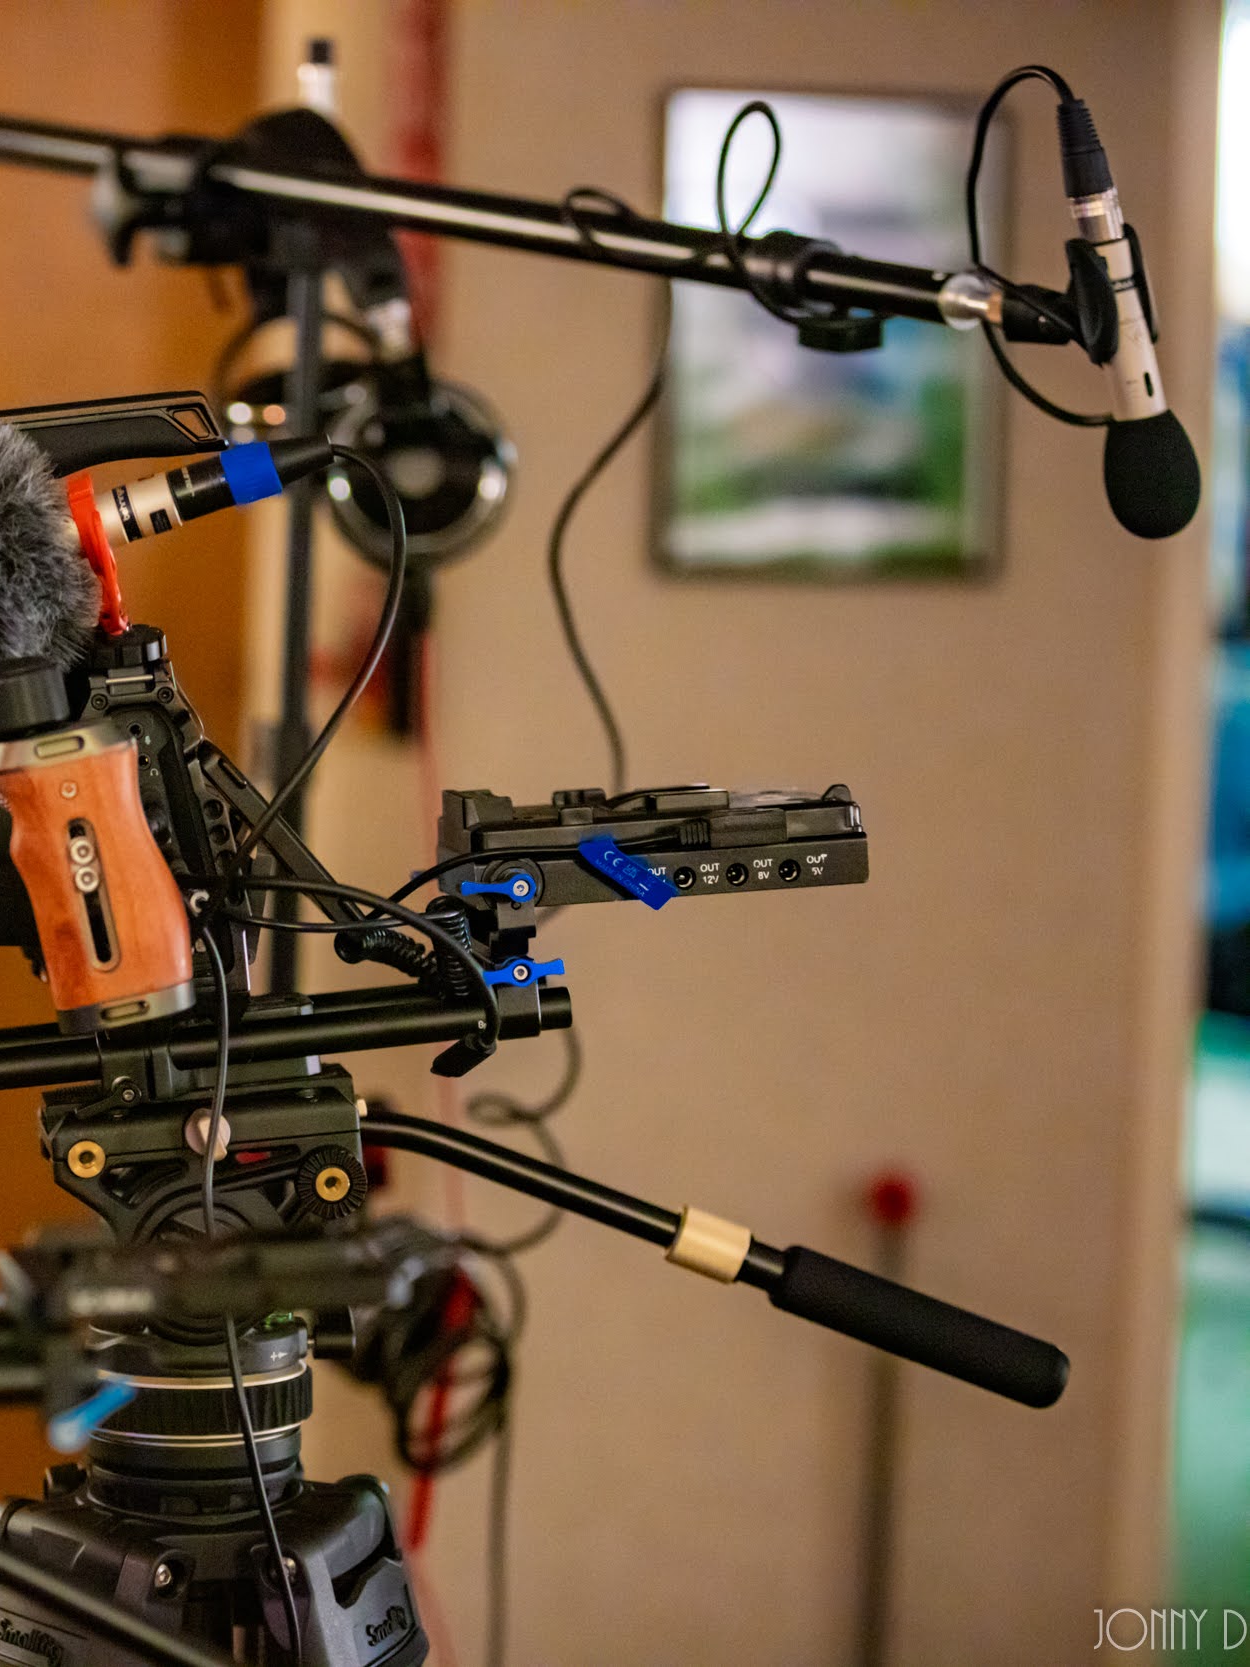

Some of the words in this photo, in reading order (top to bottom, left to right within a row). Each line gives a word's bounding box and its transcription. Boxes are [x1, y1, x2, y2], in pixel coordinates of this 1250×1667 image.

[753, 859, 772, 868] OUT
[806, 854, 827, 864] OUT
[700, 863, 720, 872] OUT
[812, 867, 823, 875] 5V
[703, 875, 719, 884] 12V
[758, 871, 770, 880] 8V
